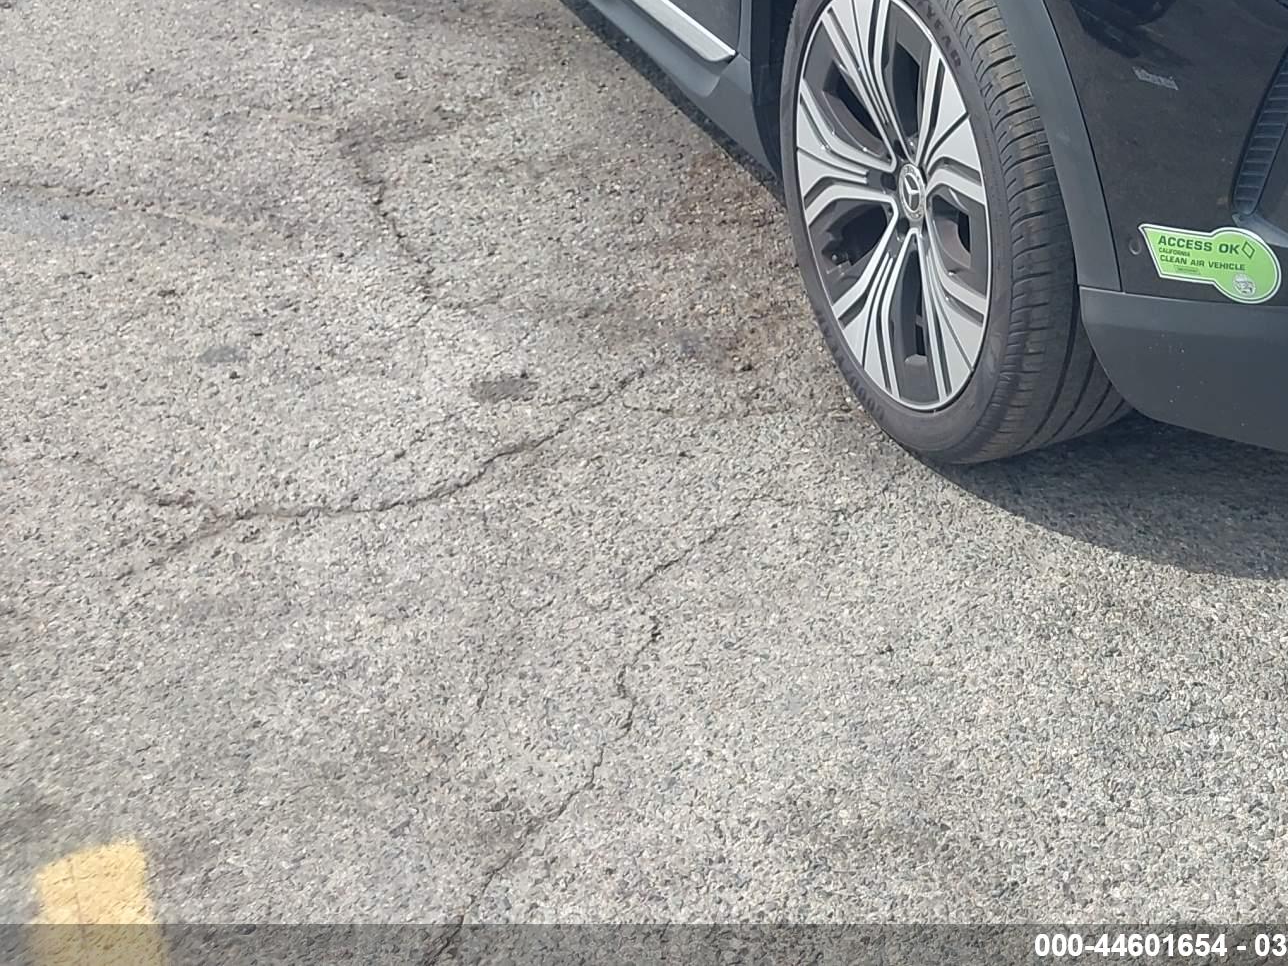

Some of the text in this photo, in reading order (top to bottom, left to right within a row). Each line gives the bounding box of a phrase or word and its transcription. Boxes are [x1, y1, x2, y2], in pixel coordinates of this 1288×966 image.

[1158, 235, 1240, 255] ACCESS OK
[1158, 247, 1191, 257] CALIFORNIA
[1160, 254, 1187, 265] CLEAN
[1190, 259, 1205, 267] AIR
[1208, 261, 1246, 271] VEHICLE
